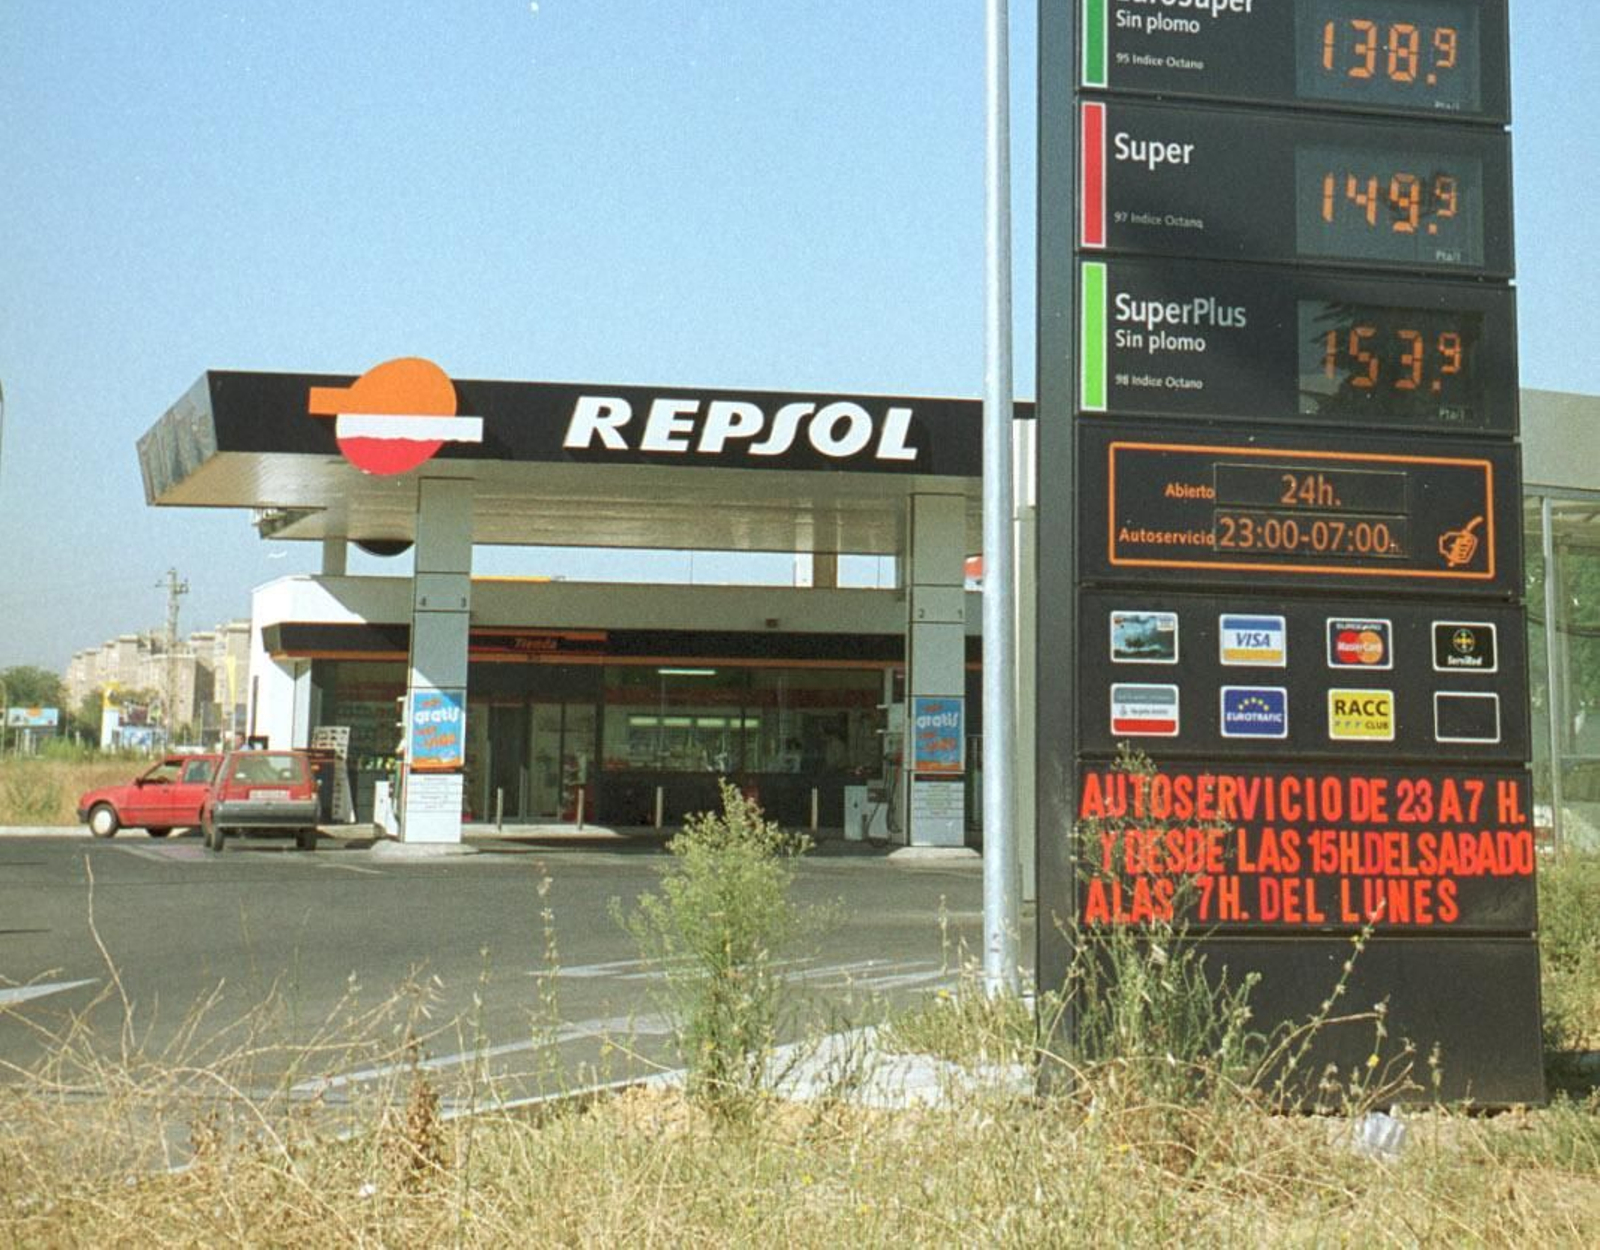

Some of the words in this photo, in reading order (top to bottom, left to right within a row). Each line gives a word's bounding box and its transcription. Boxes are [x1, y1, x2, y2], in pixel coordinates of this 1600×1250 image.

[1116, 9, 1142, 29] Sin
[1146, 12, 1201, 35] plomo
[1116, 53, 1129, 64] 95
[1114, 132, 1195, 170] Super
[1114, 211, 1128, 224] 97
[1115, 293, 1247, 330] SuperPlus
[1116, 328, 1145, 348] Sin
[1148, 331, 1206, 355] plomo
[563, 395, 919, 461] REPSOL
[1165, 482, 1216, 500] Abierto
[1119, 527, 1216, 546] Autoservicio
[1236, 632, 1271, 648] VISA
[1335, 699, 1389, 717] RACC
[1365, 720, 1389, 730] CLUB
[1080, 772, 1343, 823] AUTOSERVICIO
[1350, 775, 1389, 824] DE
[1397, 778, 1434, 824] 23
[1237, 827, 1301, 874] LAS
[1259, 876, 1325, 924] DEL
[1341, 877, 1459, 925] LUNES
